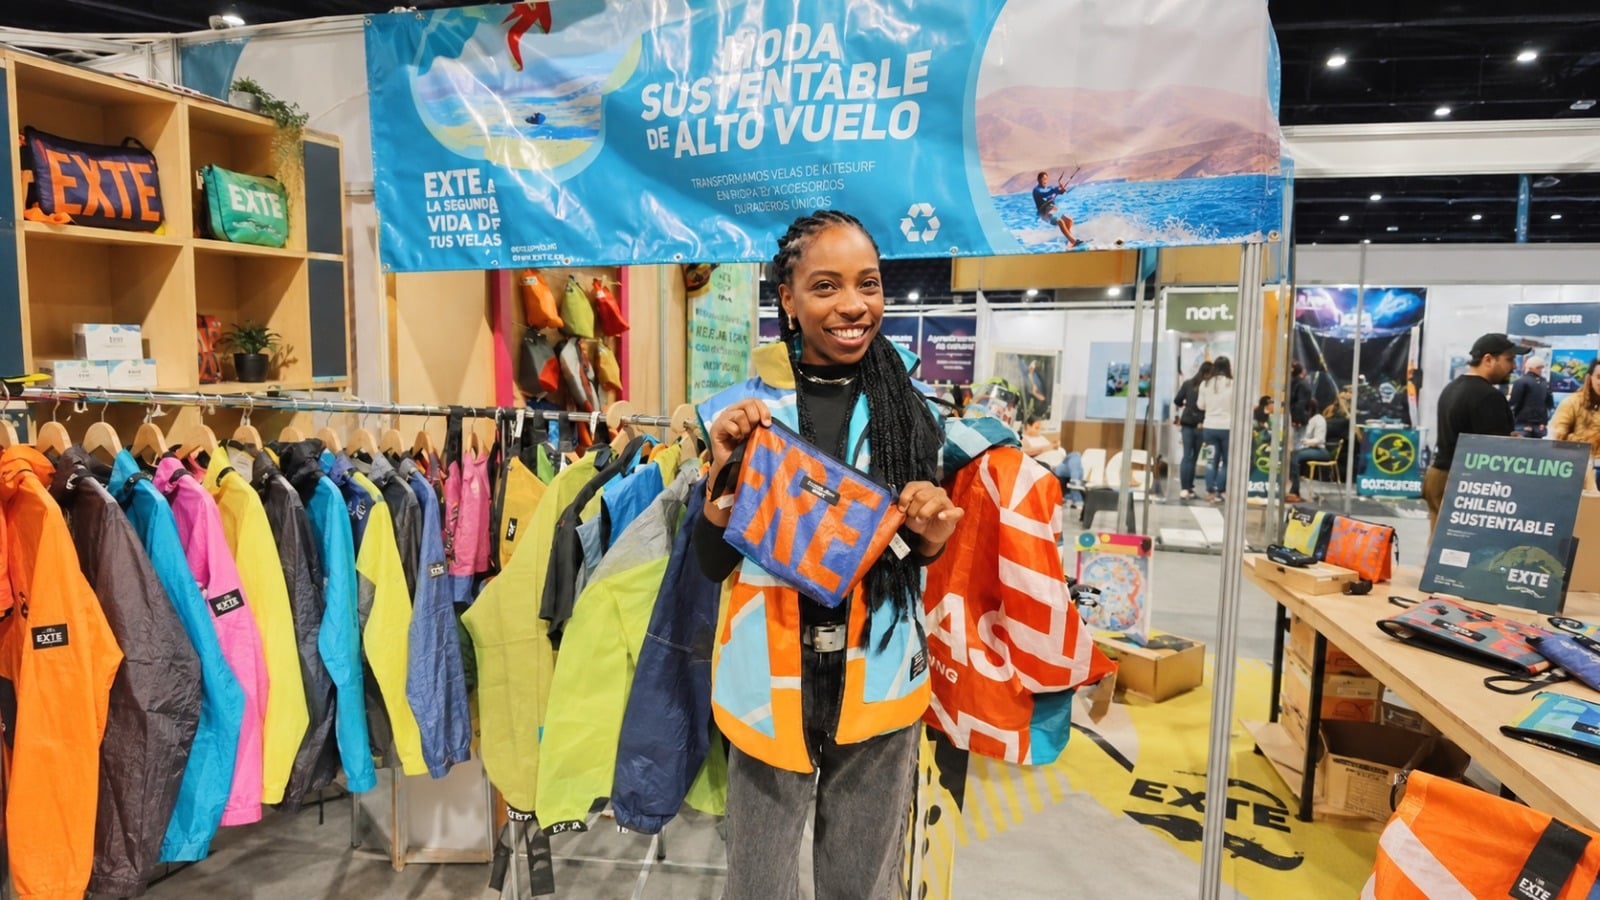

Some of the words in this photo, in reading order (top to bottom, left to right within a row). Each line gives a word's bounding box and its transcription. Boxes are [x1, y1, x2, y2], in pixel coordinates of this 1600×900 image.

[720, 23, 841, 70] MODA
[641, 50, 932, 121] SUSTENTABLE
[646, 126, 670, 150] DE
[674, 111, 765, 158] ALTO
[773, 100, 920, 145] VUELO
[46, 149, 160, 222] EXTE
[690, 169, 769, 190] TRANSFORMAMOS
[771, 166, 802, 180] VELAS
[805, 164, 819, 177] DE
[822, 160, 876, 175] KITESURF
[228, 184, 283, 219] EXTE
[426, 200, 441, 213] LA
[427, 213, 472, 232] VIDA
[428, 235, 454, 248] TUS
[456, 233, 502, 247] VELAS
[1186, 304, 1234, 320] nort.
[1464, 453, 1574, 478] UPCYCLING
[1457, 481, 1512, 498] DISEÑO
[1454, 496, 1517, 514] CHILENO
[1450, 512, 1555, 536] SUSTENTABLE
[1507, 568, 1550, 588] EXTE
[36, 632, 63, 643] EXTE
[1130, 778, 1291, 833] EXTE
[1519, 877, 1552, 900] EXTE
